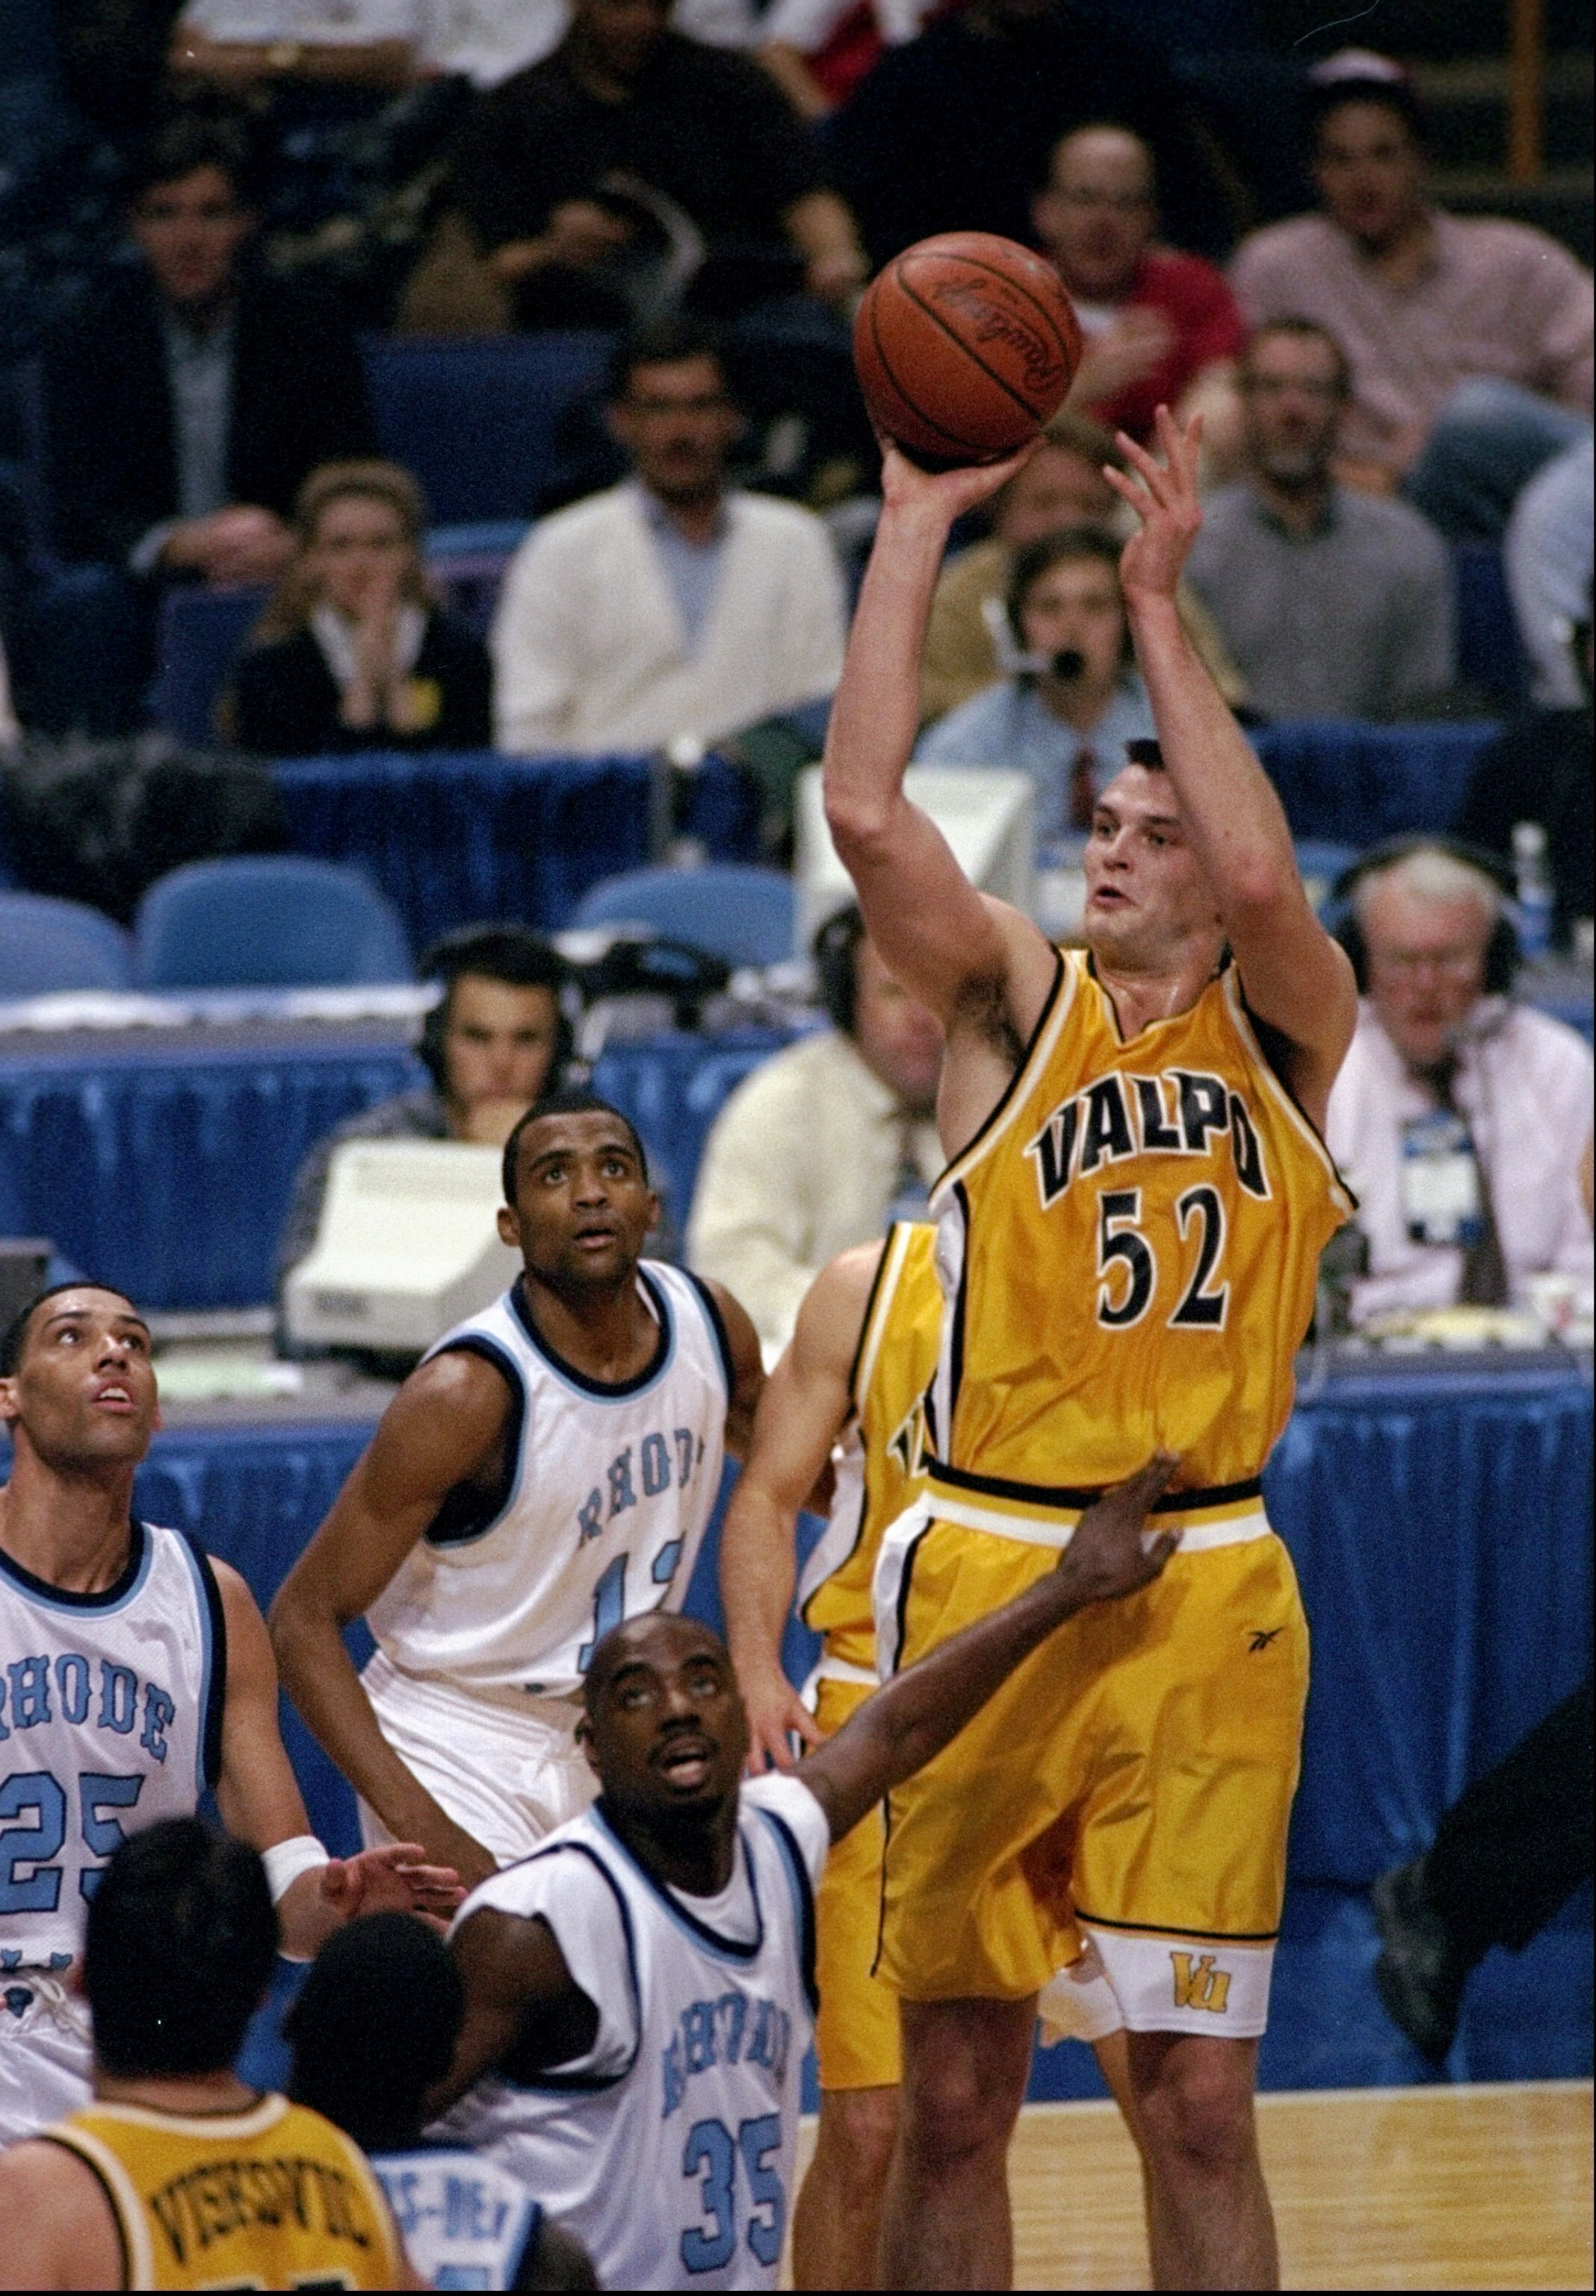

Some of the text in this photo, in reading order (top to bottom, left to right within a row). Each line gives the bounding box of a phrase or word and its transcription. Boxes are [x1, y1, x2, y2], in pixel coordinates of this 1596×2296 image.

[1023, 1067, 1272, 1211] VALPO
[1096, 1184, 1230, 1333] 52
[680, 2112, 786, 2274] 35
